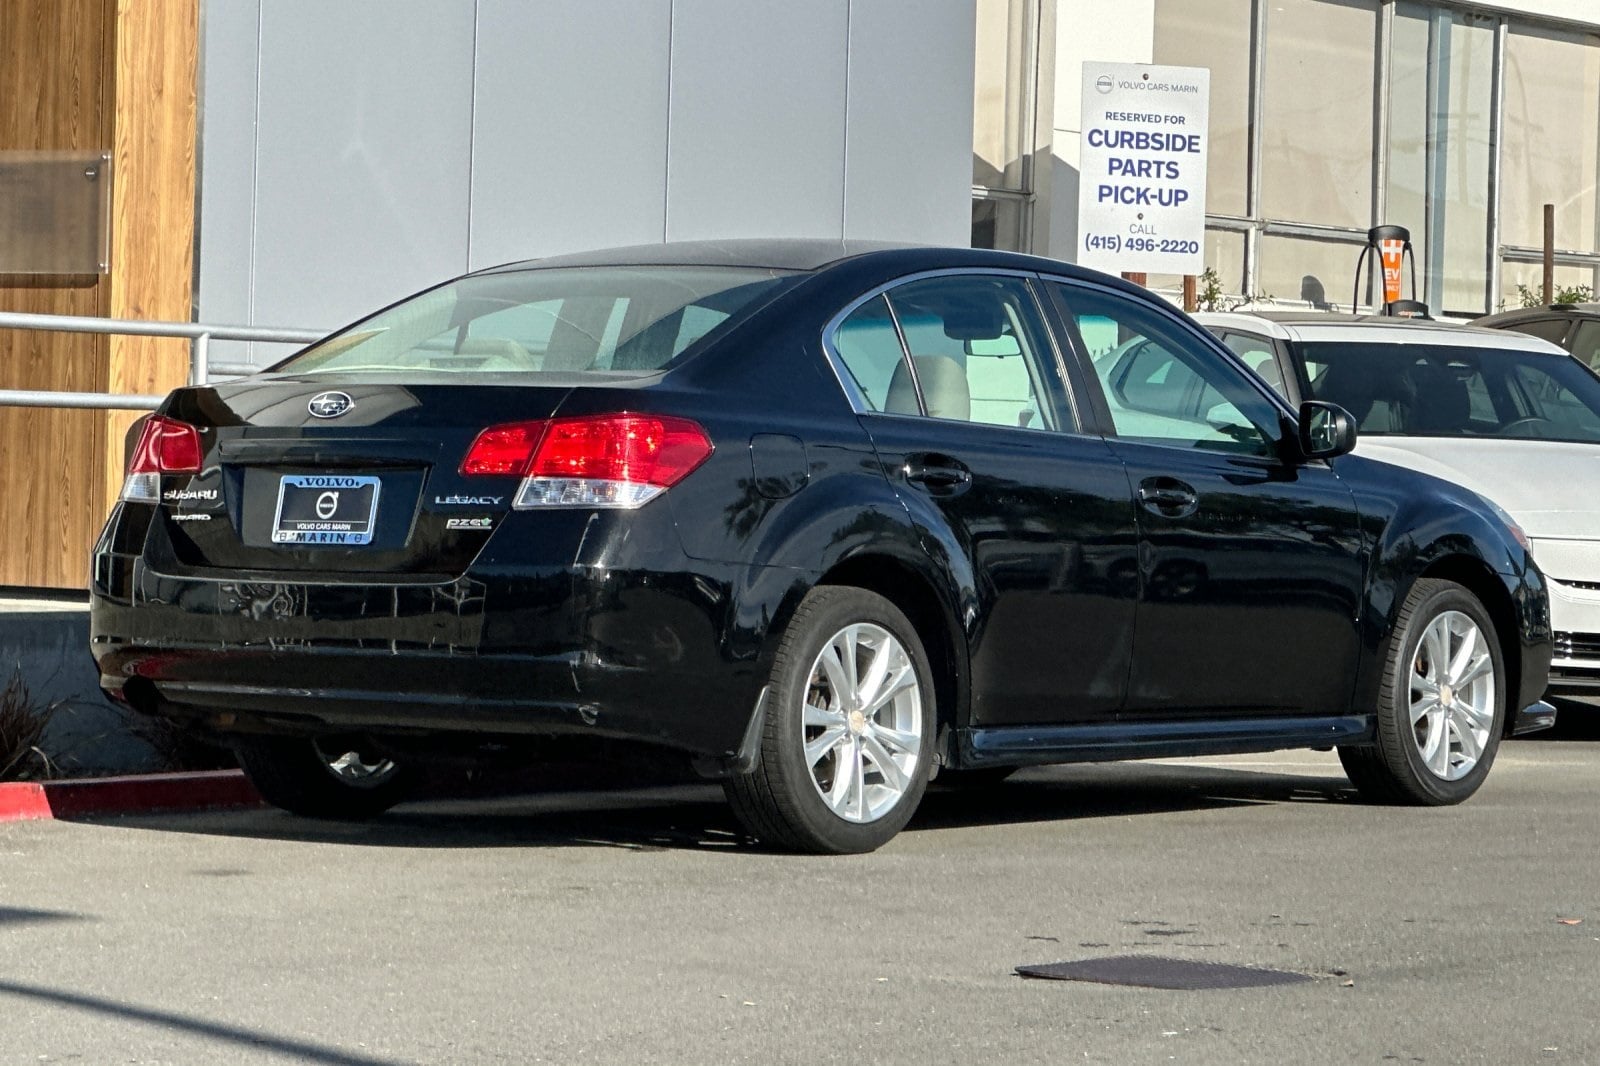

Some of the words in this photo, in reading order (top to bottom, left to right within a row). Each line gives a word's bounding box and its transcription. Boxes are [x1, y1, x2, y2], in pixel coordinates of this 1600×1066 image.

[1118, 81, 1146, 90] VOLVO
[1147, 83, 1170, 92] CARS
[1171, 84, 1199, 93] MARIN
[1105, 111, 1162, 124] RESERVED
[1164, 115, 1186, 125] FOR
[1088, 128, 1201, 153] CURBSIDE
[1108, 157, 1180, 180] PARTS
[1098, 185, 1189, 207] PICK-UP
[1129, 224, 1157, 235] CALL
[1085, 233, 1122, 253] (415)
[1125, 237, 1199, 254] 496-2220
[1385, 268, 1400, 280] EV
[304, 477, 355, 487] VOLVO
[163, 489, 218, 500] SUBARU
[435, 495, 504, 505] LEGACY
[332, 523, 351, 531] MARIN
[295, 532, 346, 543] MARIN
